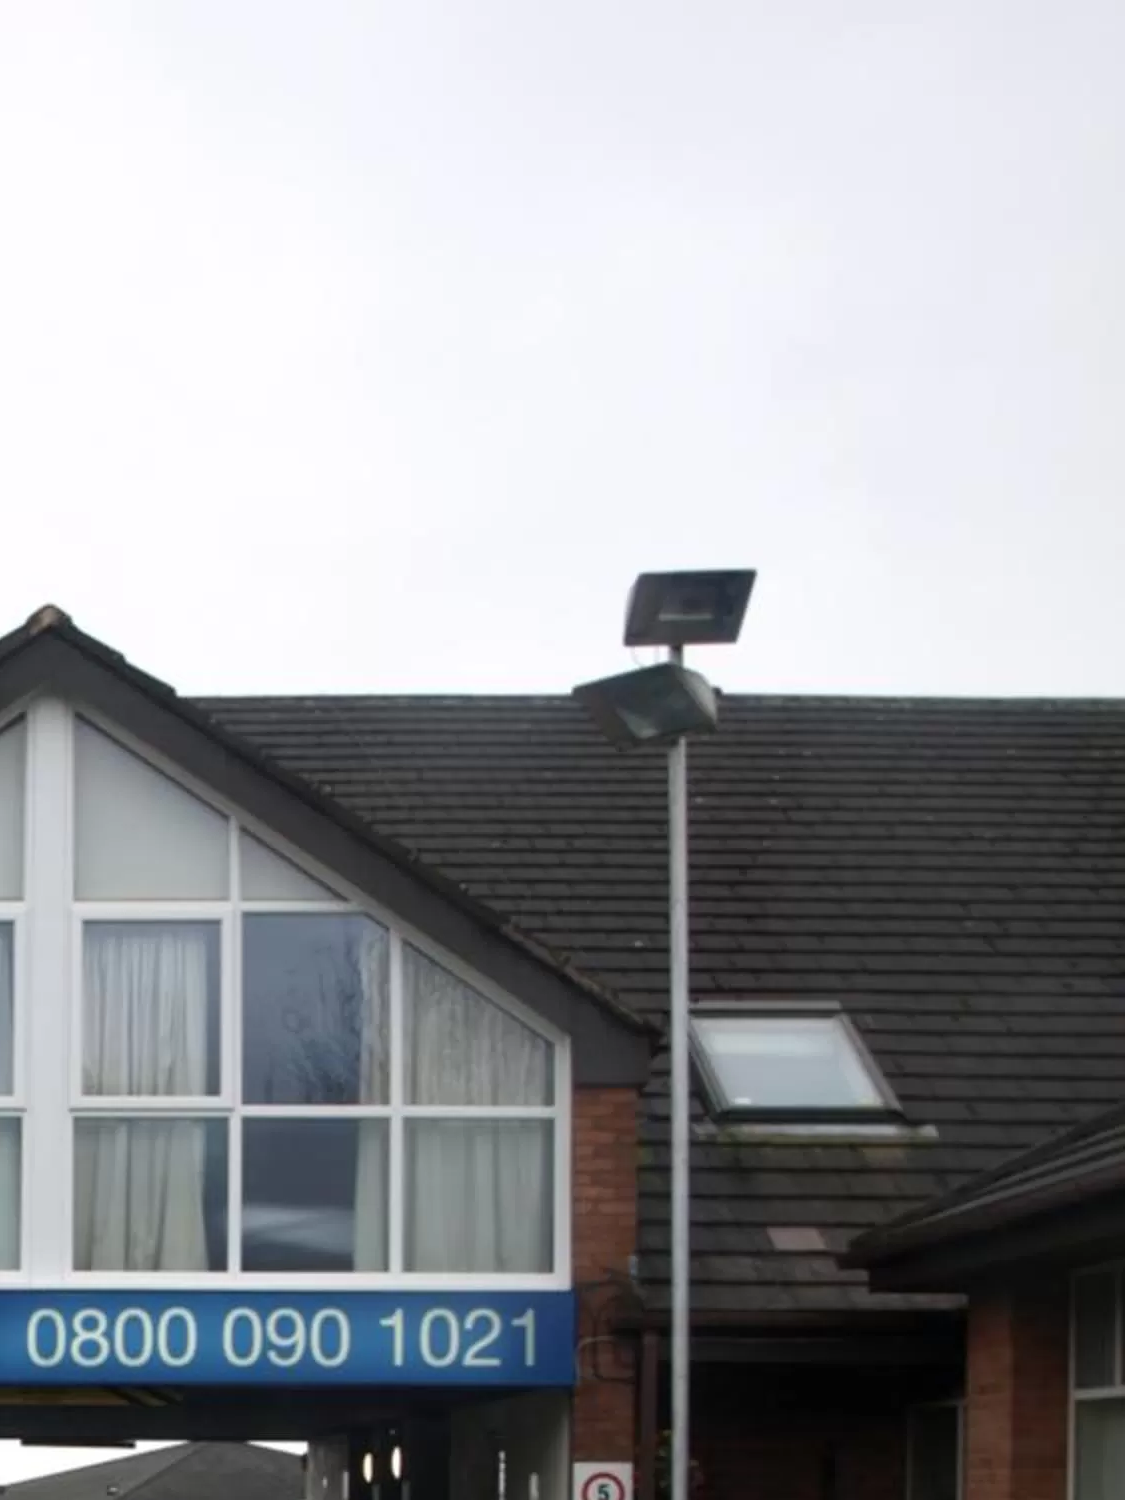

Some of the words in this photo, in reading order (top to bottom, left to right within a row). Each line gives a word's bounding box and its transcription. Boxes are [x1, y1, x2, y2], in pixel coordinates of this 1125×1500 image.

[26, 1307, 197, 1368] 0800
[222, 1307, 351, 1368] 090
[379, 1308, 538, 1368] 1021
